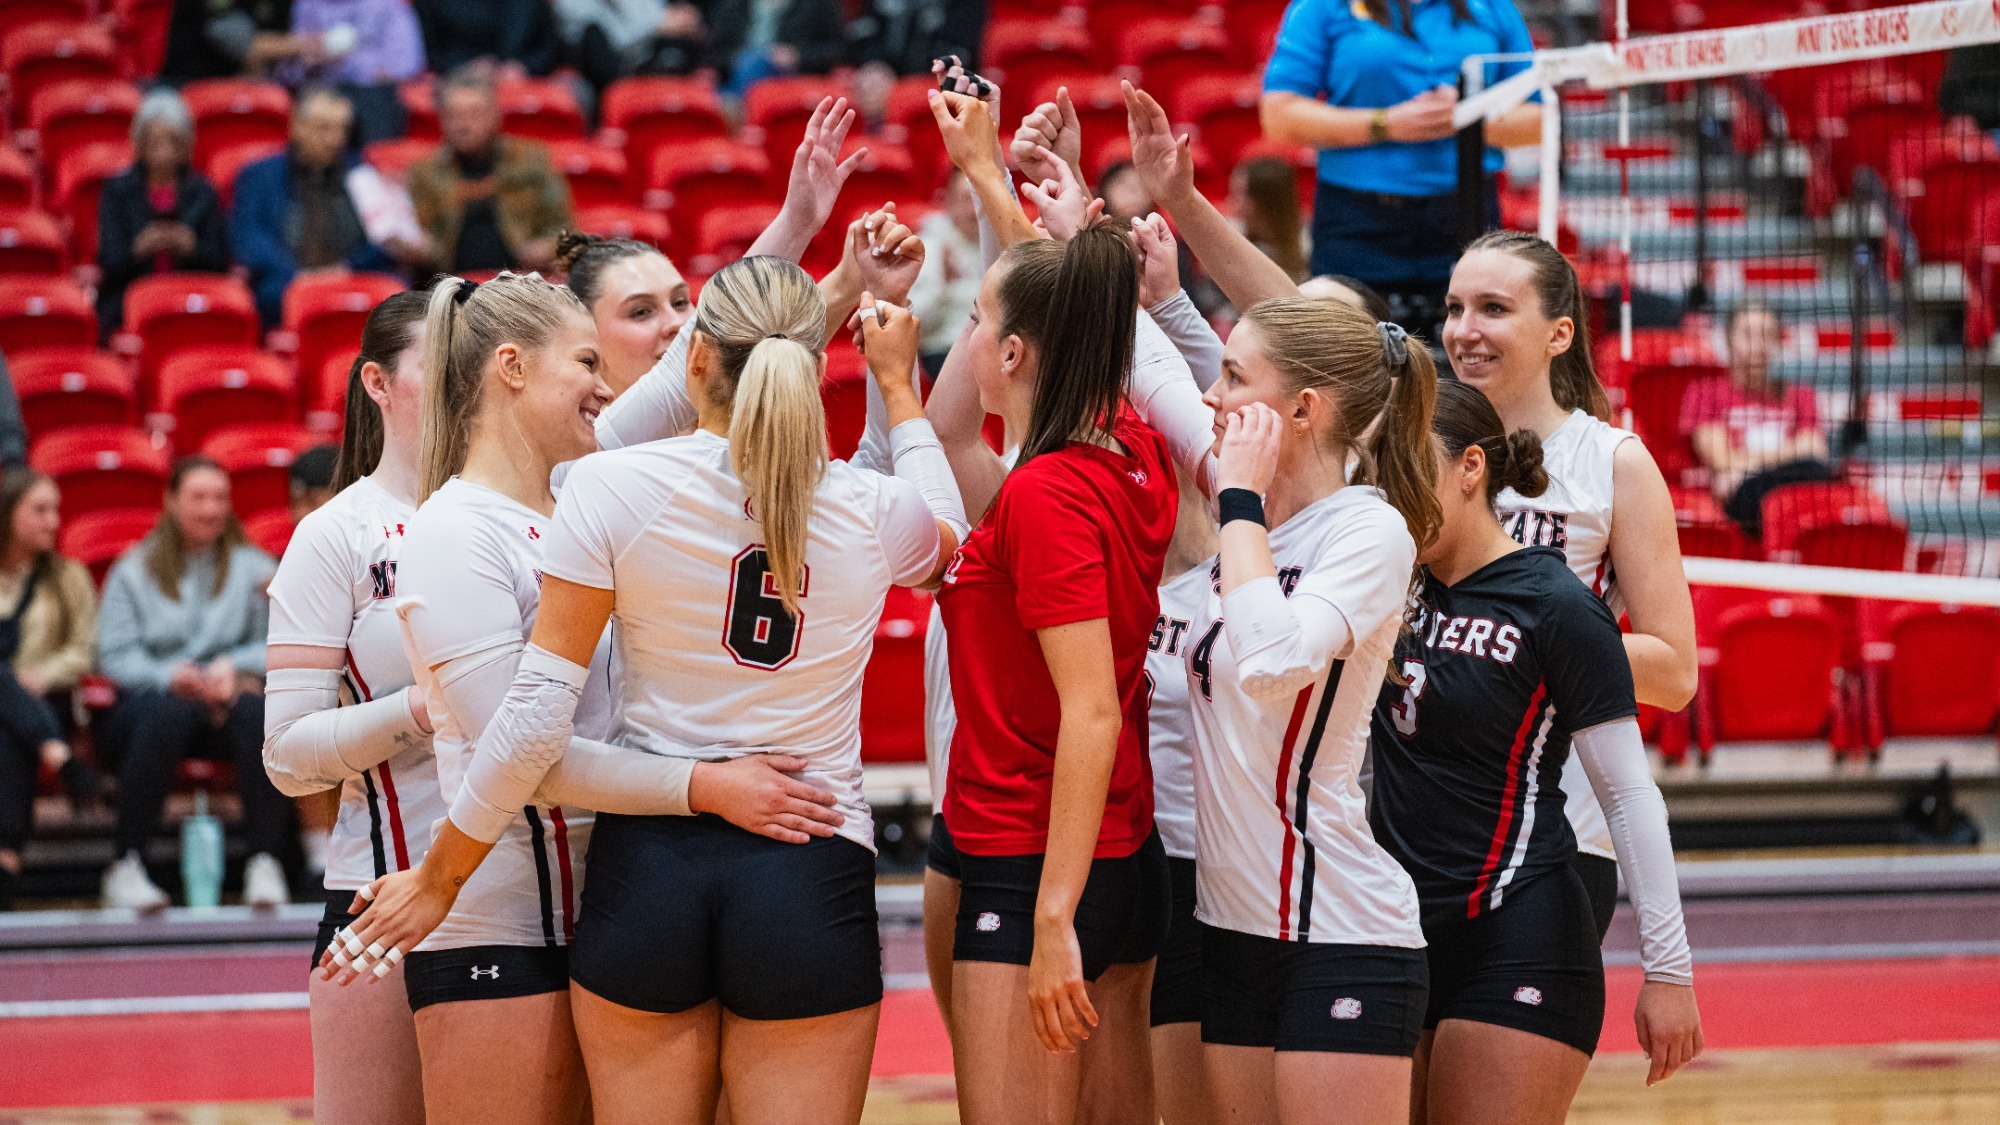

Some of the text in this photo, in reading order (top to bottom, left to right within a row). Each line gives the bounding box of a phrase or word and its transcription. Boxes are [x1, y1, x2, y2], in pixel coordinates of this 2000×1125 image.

[721, 543, 810, 672] 6
[1191, 617, 1224, 703] 4
[1389, 657, 1428, 740] 3
